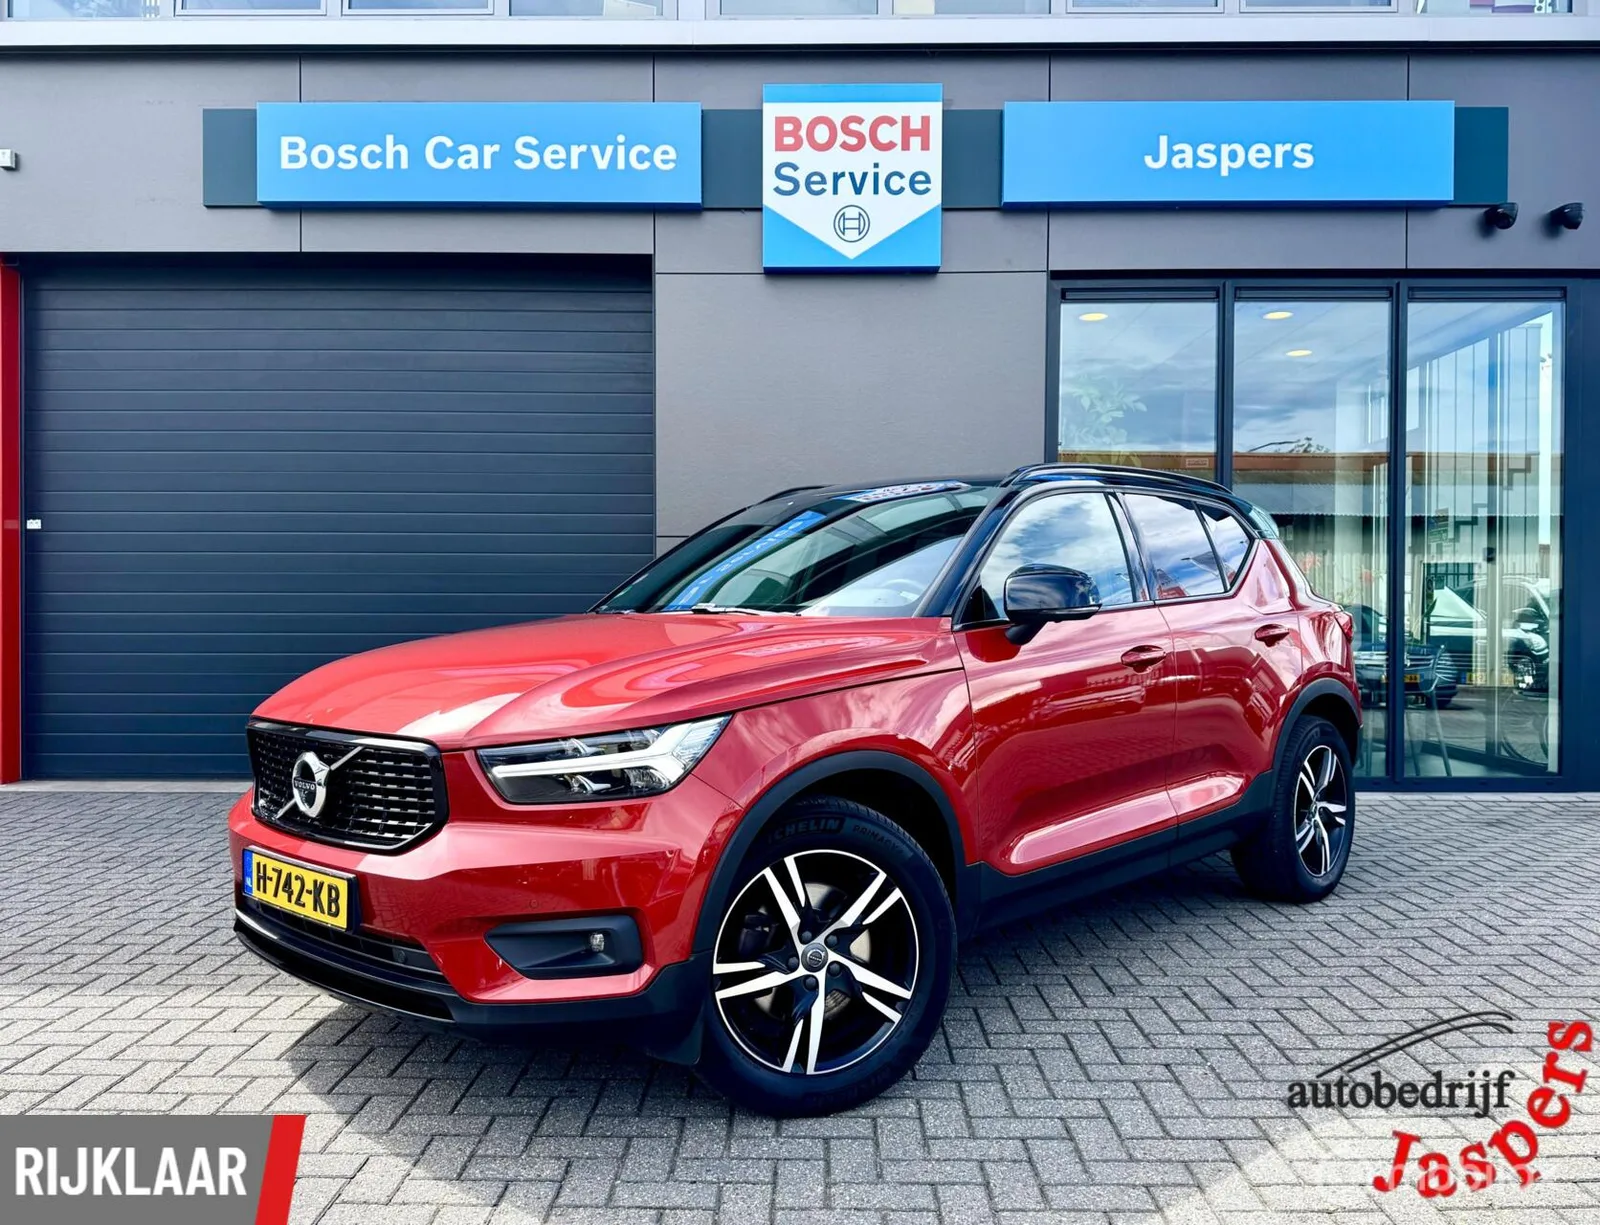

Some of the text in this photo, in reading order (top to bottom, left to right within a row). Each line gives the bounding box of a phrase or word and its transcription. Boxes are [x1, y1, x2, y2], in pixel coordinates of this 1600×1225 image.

[280, 133, 677, 170] Bosch Car Service
[774, 115, 931, 152] BOSCH
[1143, 134, 1315, 177] Jaspers
[773, 161, 932, 196] Service
[294, 780, 315, 790] VOLVO
[255, 861, 341, 919] H-742-KB
